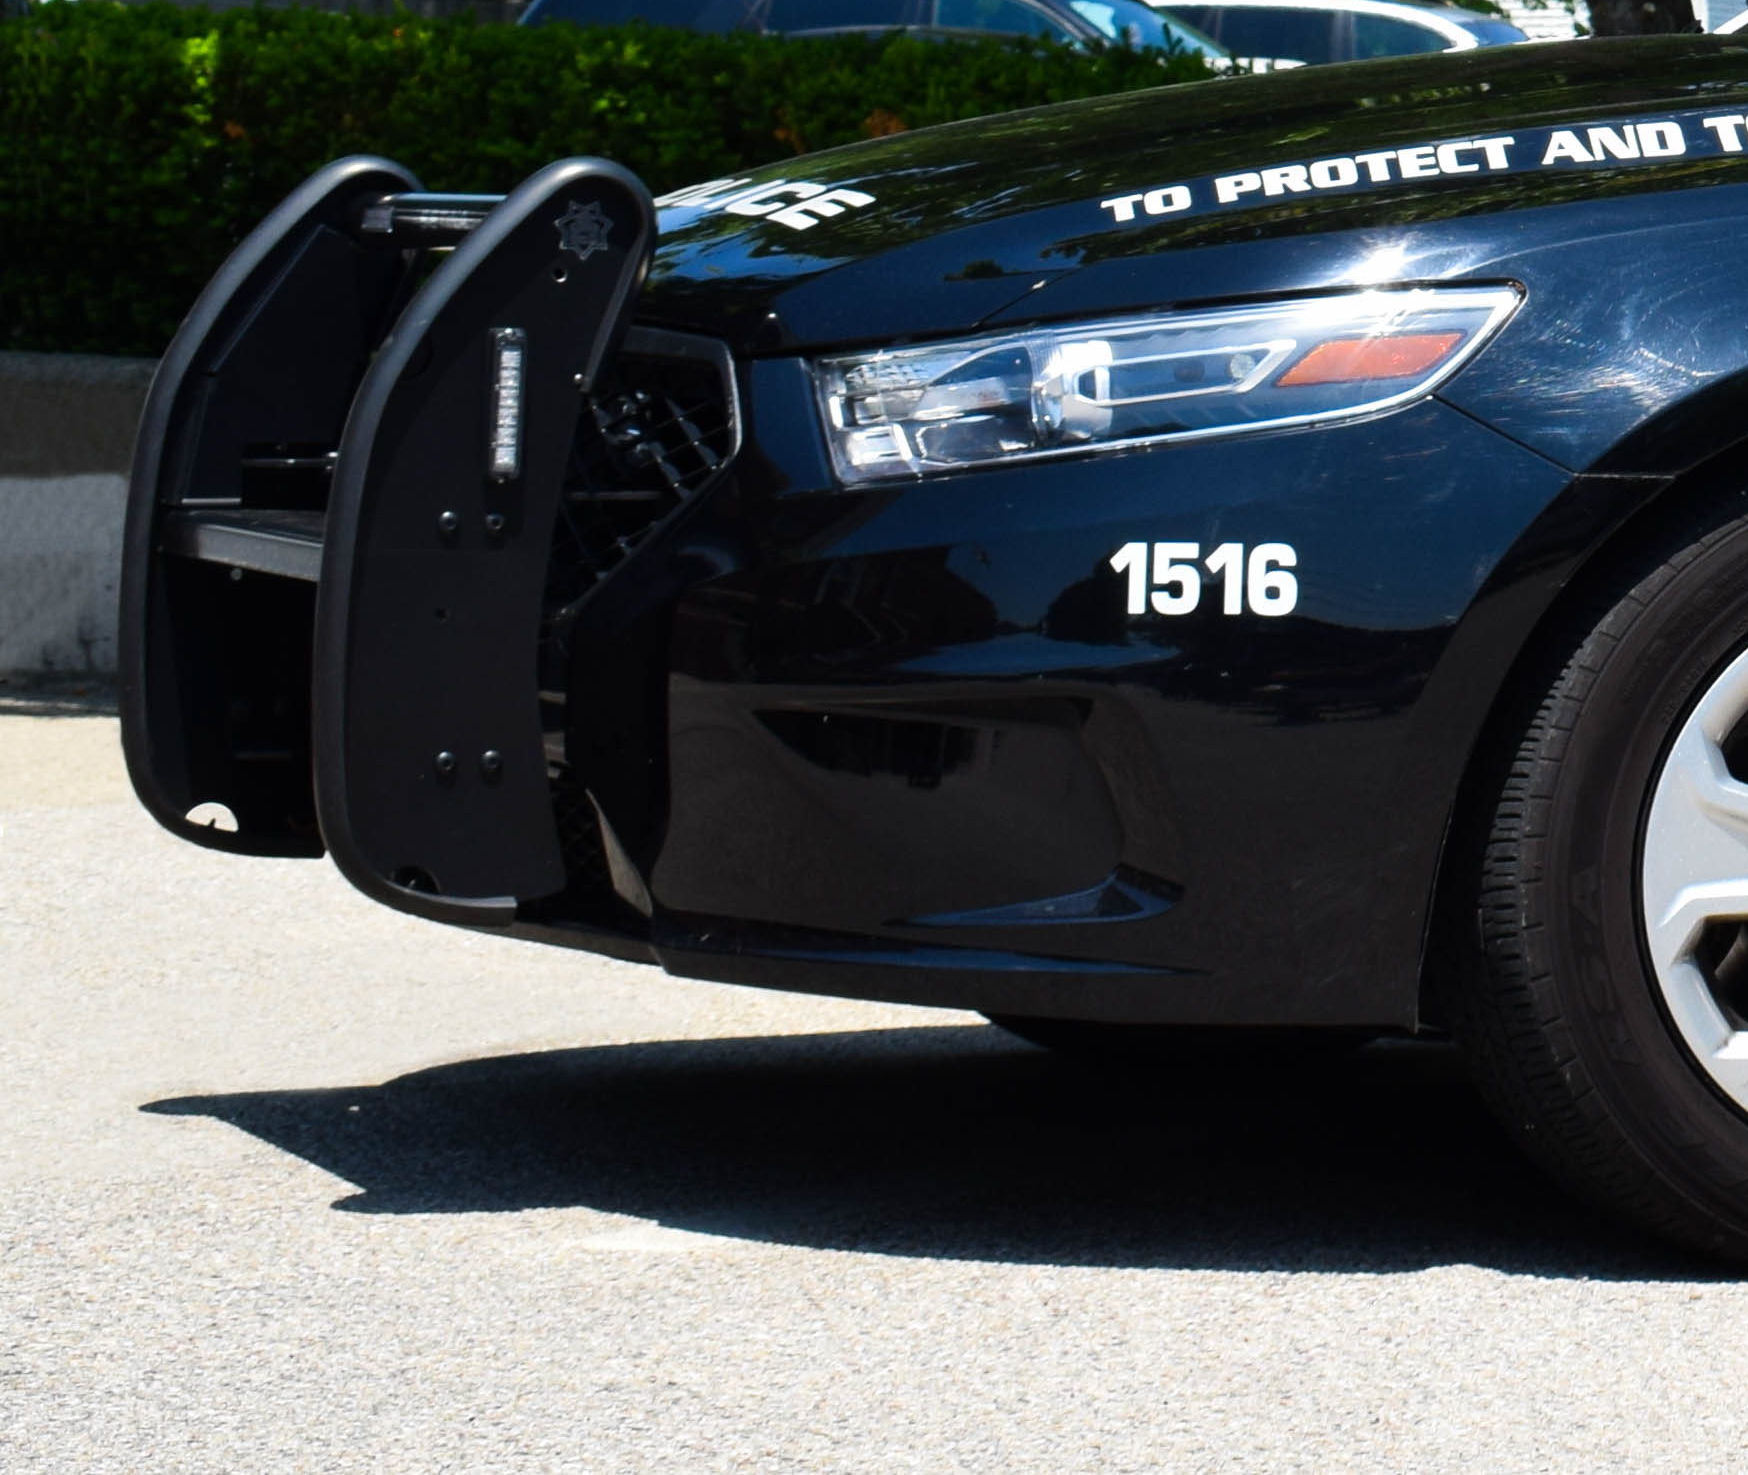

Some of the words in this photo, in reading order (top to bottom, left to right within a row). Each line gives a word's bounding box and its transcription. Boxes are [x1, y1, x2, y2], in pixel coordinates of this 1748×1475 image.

[653, 178, 876, 231] OLICE
[1100, 185, 1192, 222] TO
[1214, 136, 1515, 204] PROTECT
[1541, 121, 1687, 166] AND
[1109, 542, 1299, 617] 1516
